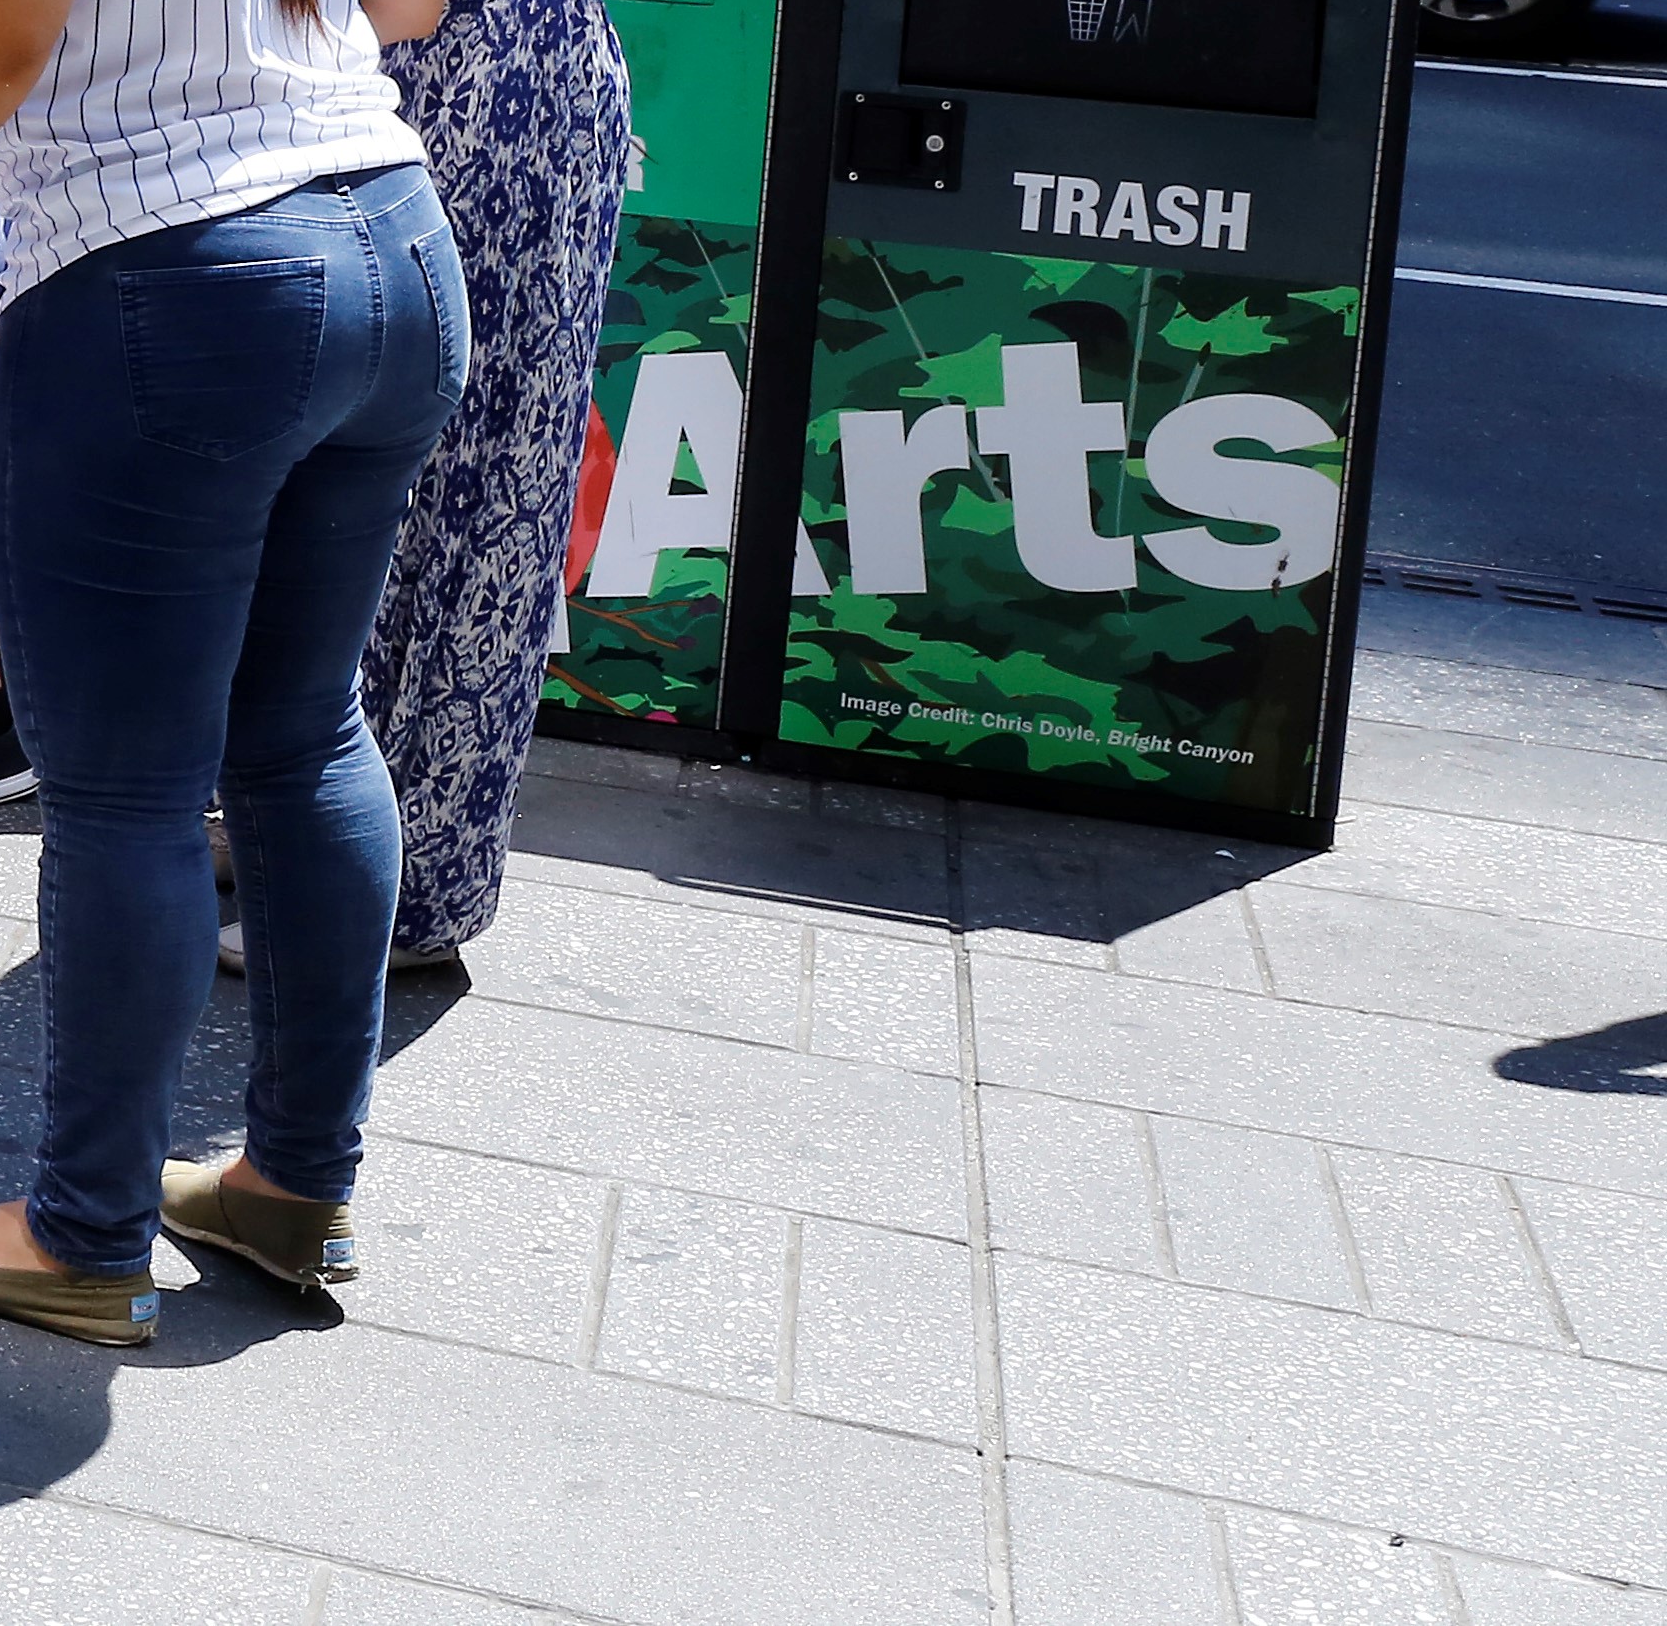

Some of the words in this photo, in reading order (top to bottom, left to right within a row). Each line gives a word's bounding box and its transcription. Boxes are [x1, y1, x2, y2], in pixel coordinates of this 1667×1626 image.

[1013, 170, 1252, 253] TRASH
[586, 341, 1343, 599] Arts
[840, 691, 902, 717] Image
[908, 700, 976, 726] Credit:
[981, 711, 1033, 735] Chris
[1039, 719, 1101, 744] Doyle,
[1107, 729, 1173, 753] Bright
[1177, 738, 1256, 766] Canyon
